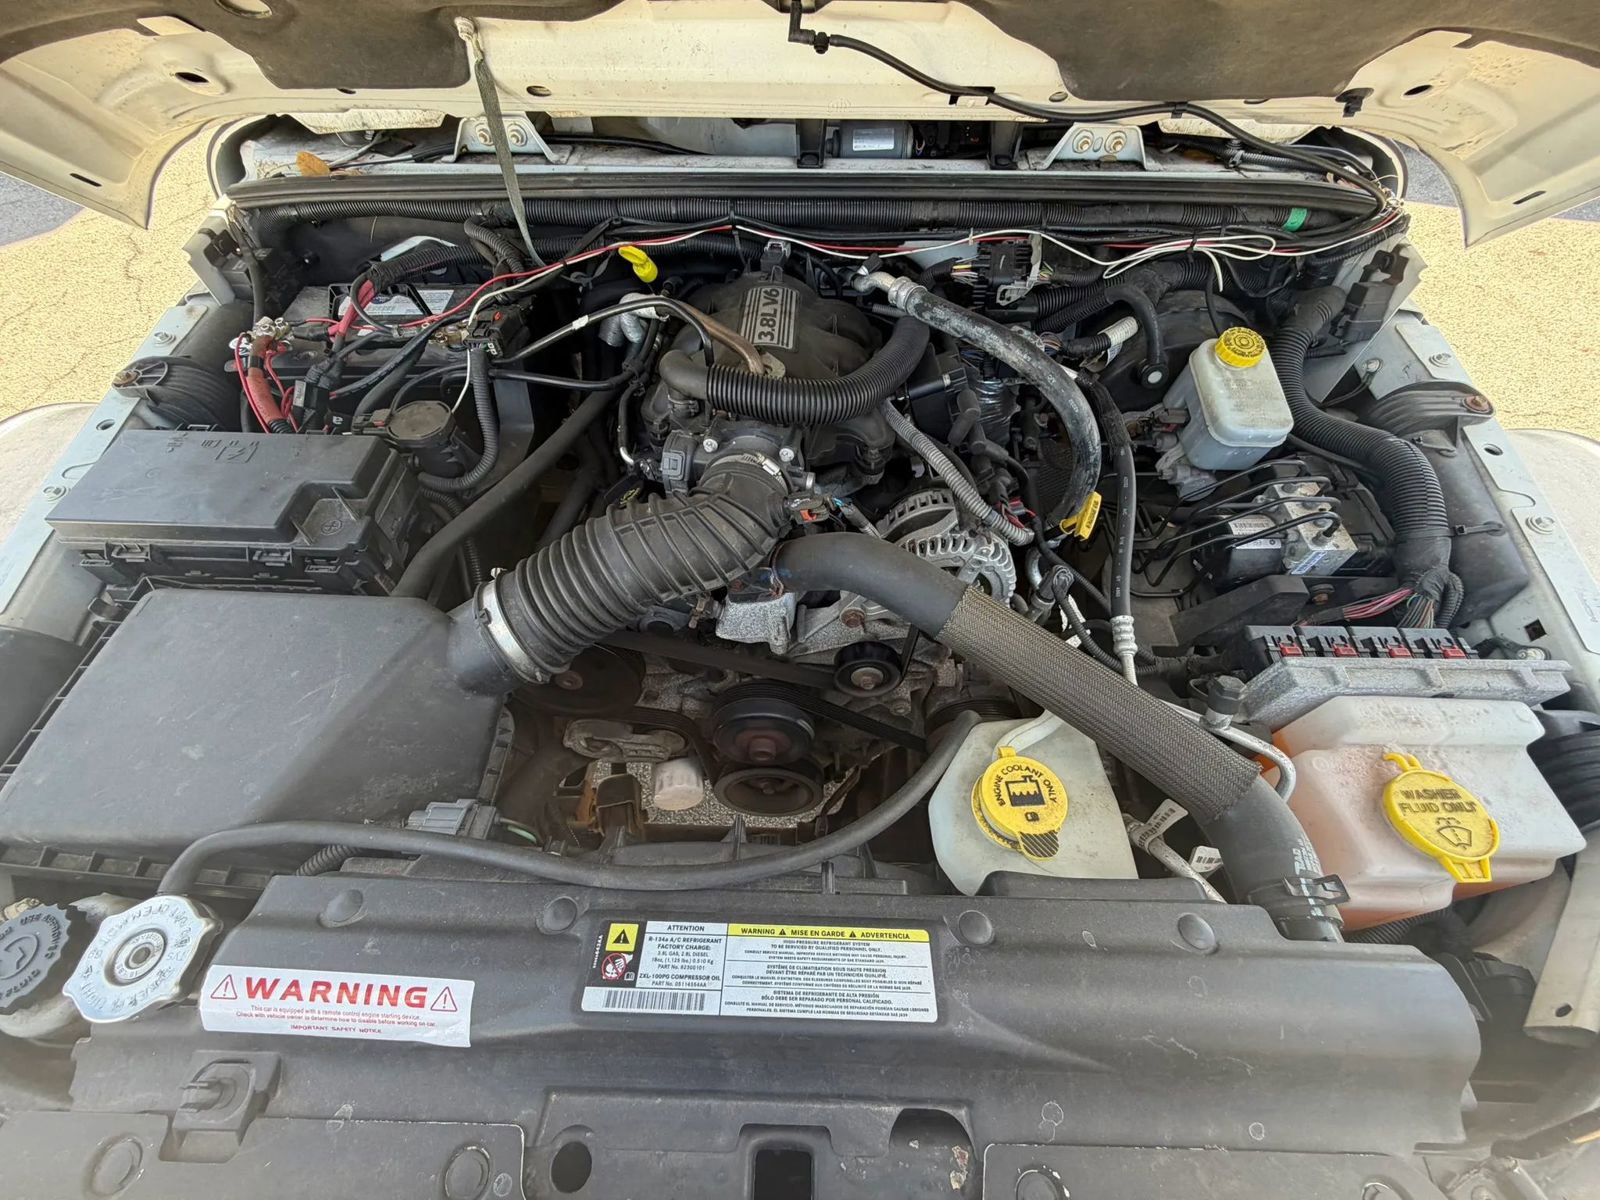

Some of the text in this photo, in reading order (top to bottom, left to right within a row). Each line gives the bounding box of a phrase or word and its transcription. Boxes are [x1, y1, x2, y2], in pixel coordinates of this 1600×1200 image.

[758, 288, 780, 341] 3.8L V6
[1001, 764, 1045, 778] COOLANT
[1043, 779, 1058, 803] ONLY
[1400, 788, 1462, 800] WASHER
[1398, 801, 1477, 813] FLUID ONLY
[246, 977, 428, 1008] WARNING
